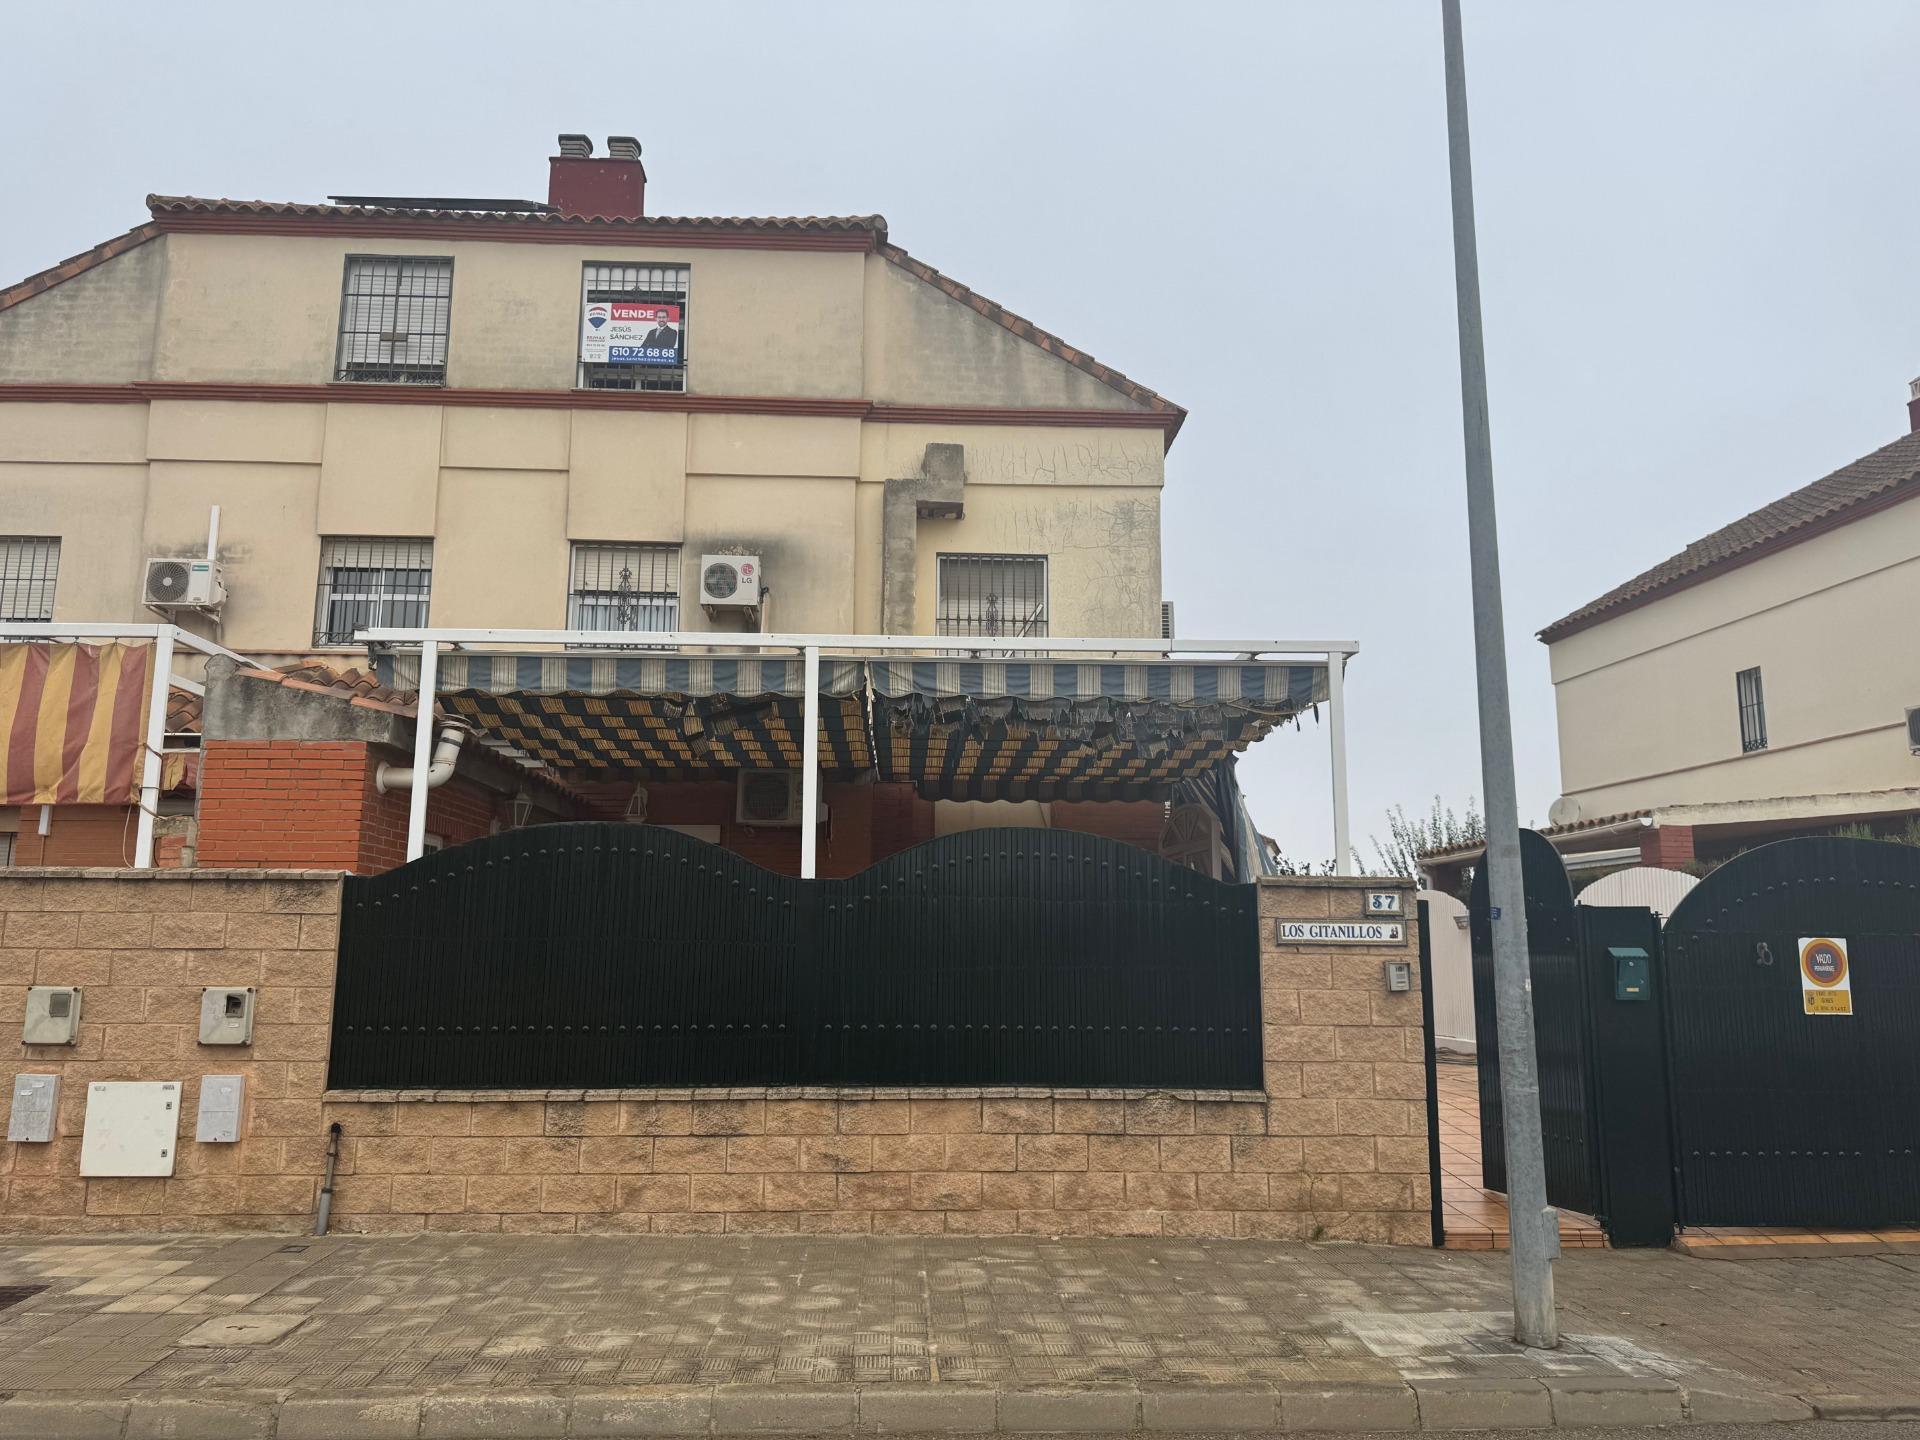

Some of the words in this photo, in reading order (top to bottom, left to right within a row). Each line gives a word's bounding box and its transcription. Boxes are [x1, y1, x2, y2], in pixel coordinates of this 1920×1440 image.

[612, 309, 654, 318] VENDE
[610, 325, 632, 333] JESÚS
[609, 333, 644, 341] SÁNCHEZ
[612, 347, 630, 356] 610
[632, 347, 645, 357] 72
[646, 348, 660, 357] 68
[661, 348, 675, 358] 68
[1372, 895, 1396, 910] 37
[1282, 924, 1304, 938] LOS
[1309, 925, 1383, 939] GITANILLOS
[1815, 953, 1832, 964] VADO
